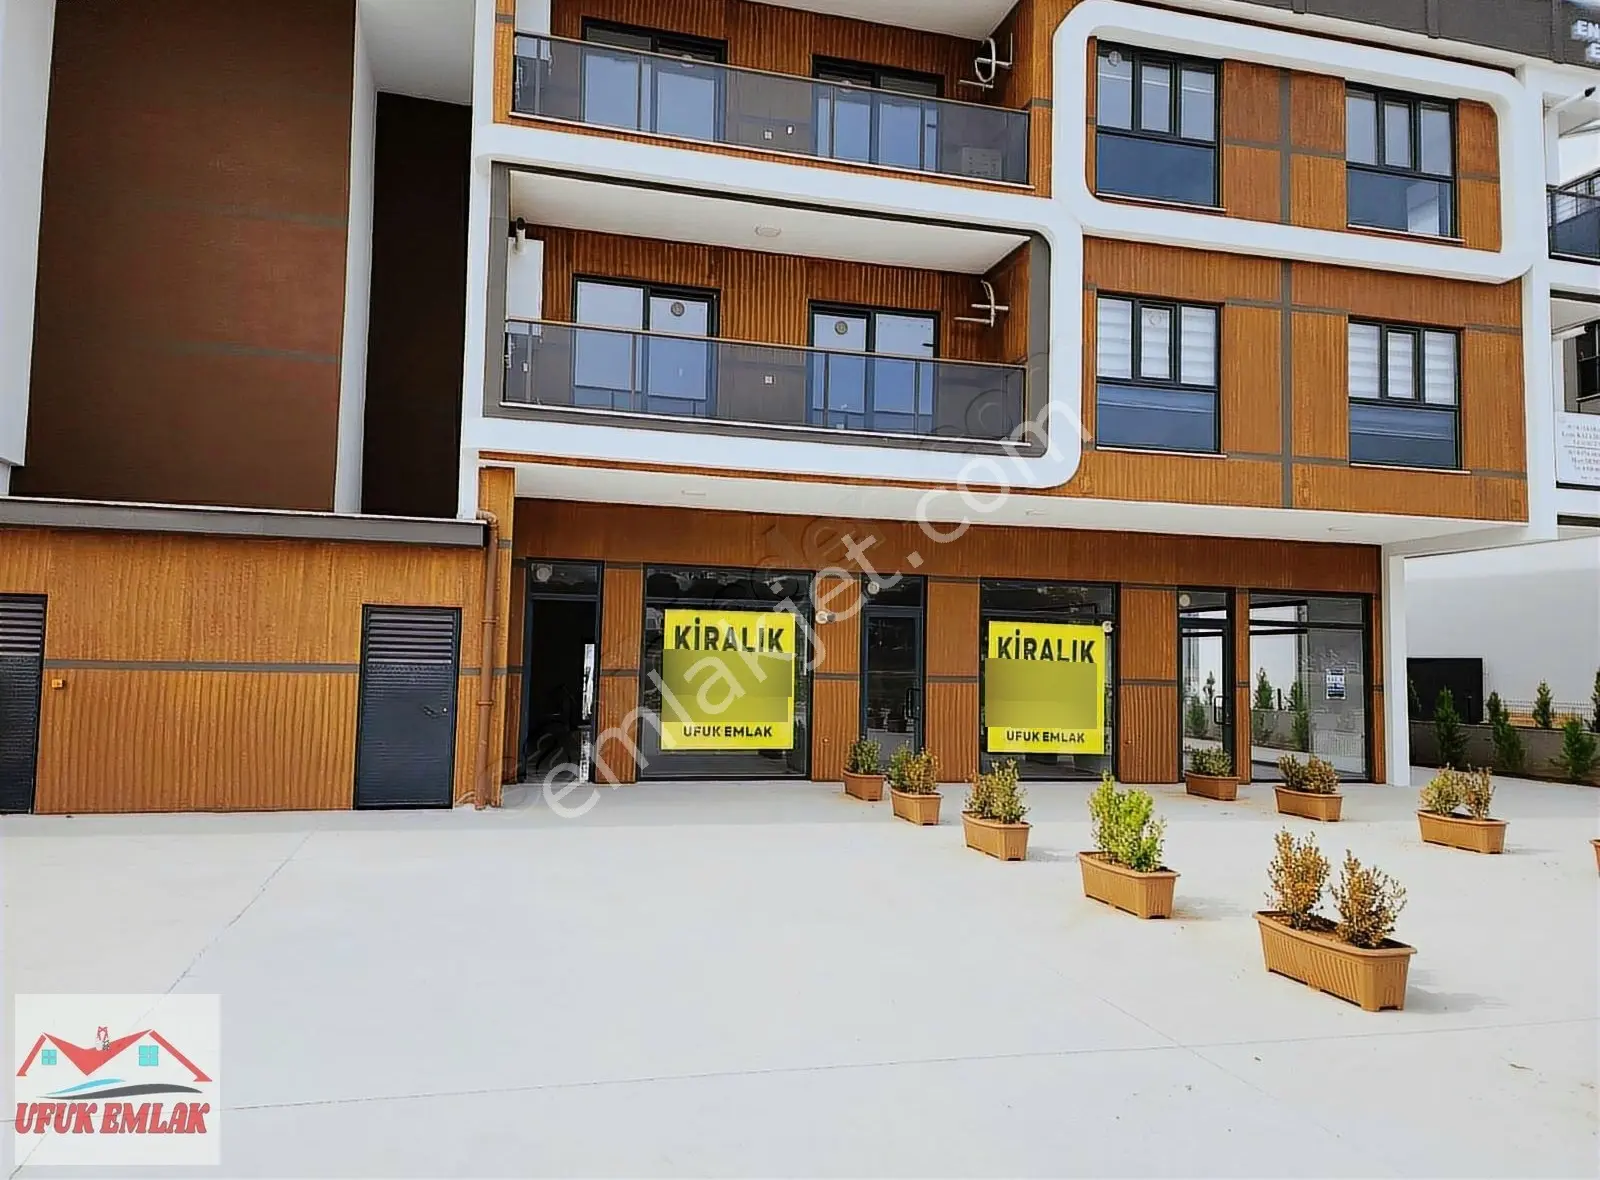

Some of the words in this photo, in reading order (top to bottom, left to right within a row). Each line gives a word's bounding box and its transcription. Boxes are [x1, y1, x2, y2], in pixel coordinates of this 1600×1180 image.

[674, 616, 785, 653] KİRALIK
[997, 628, 1096, 664] KİRALIK
[683, 725, 721, 738] UFUK
[723, 725, 773, 738] EMLAK
[1006, 730, 1041, 742] UFUK
[1042, 731, 1086, 744] EMLAK
